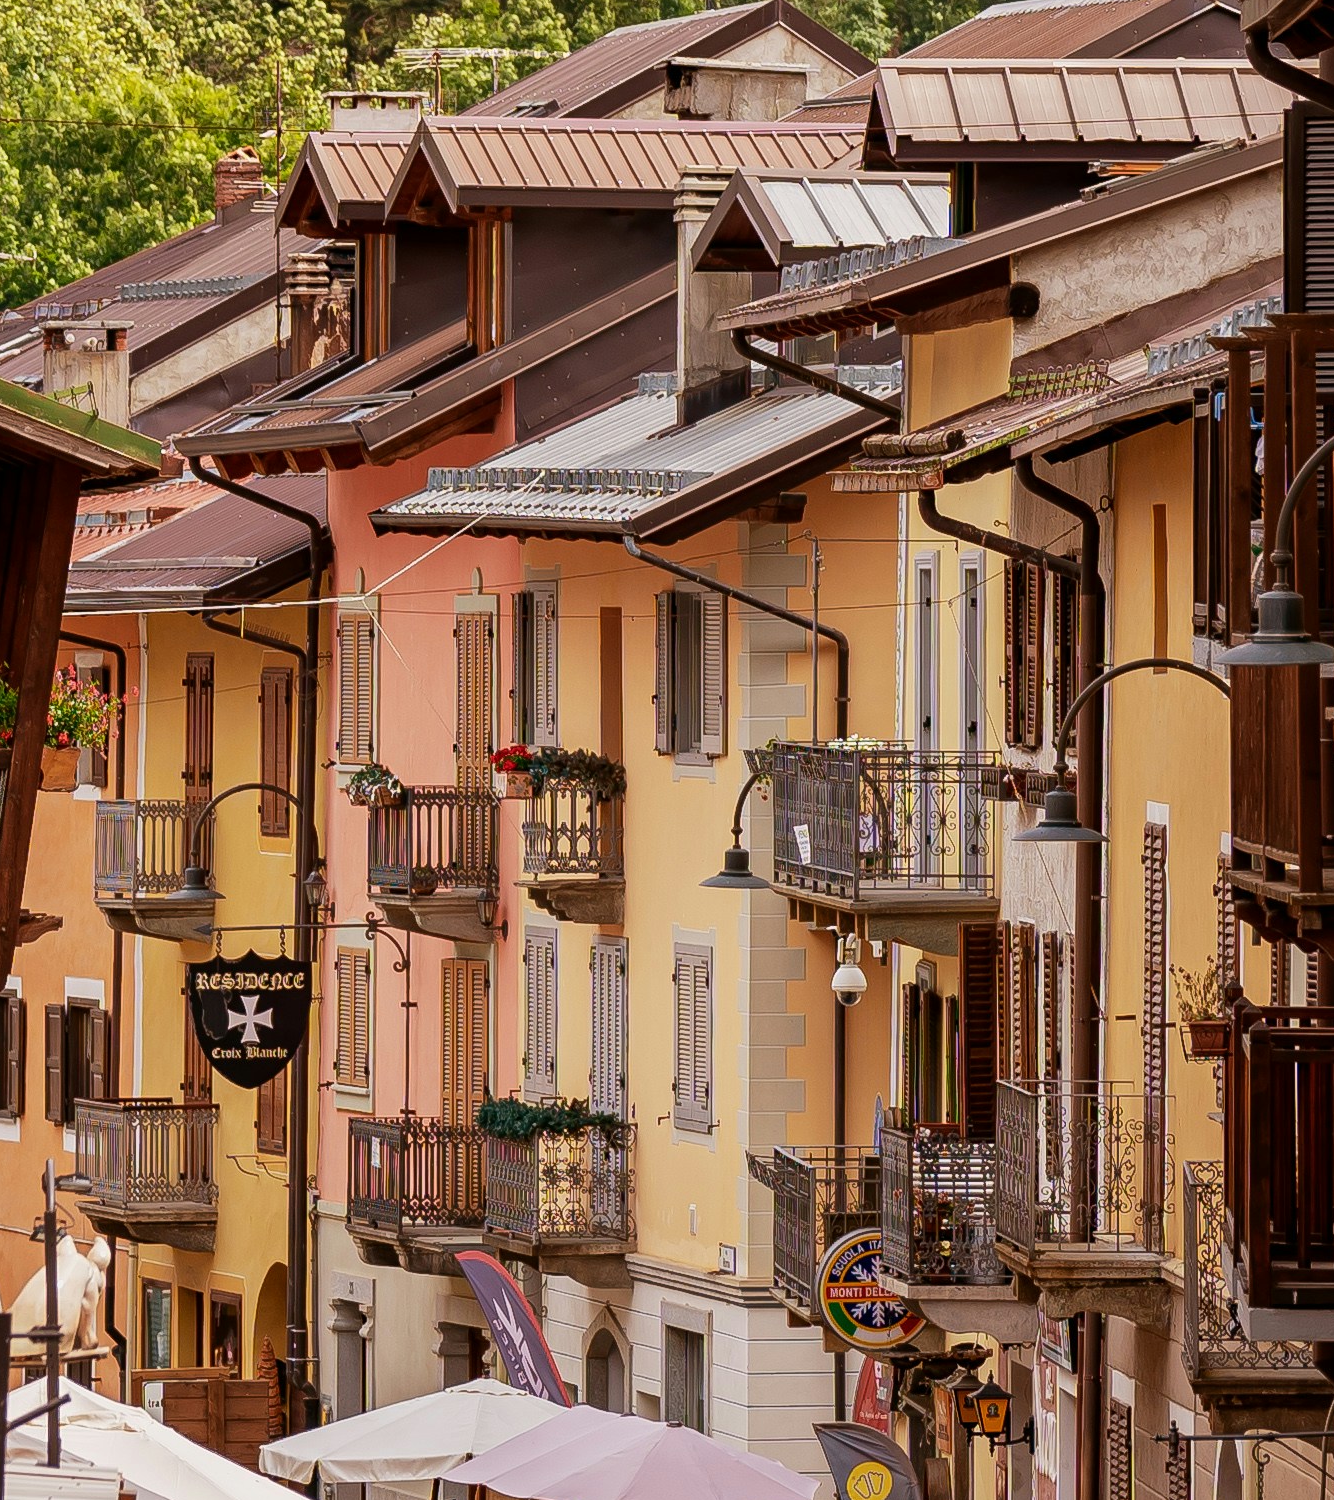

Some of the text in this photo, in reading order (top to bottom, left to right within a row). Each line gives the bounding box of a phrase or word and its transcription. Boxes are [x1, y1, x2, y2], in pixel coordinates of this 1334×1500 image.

[195, 971, 305, 991] RESIDENCE
[211, 1046, 288, 1060] Croix Blanche
[831, 1243, 865, 1277] SCUOLA
[829, 1287, 863, 1298] MONTI
[147, 1398, 161, 1408] tra
